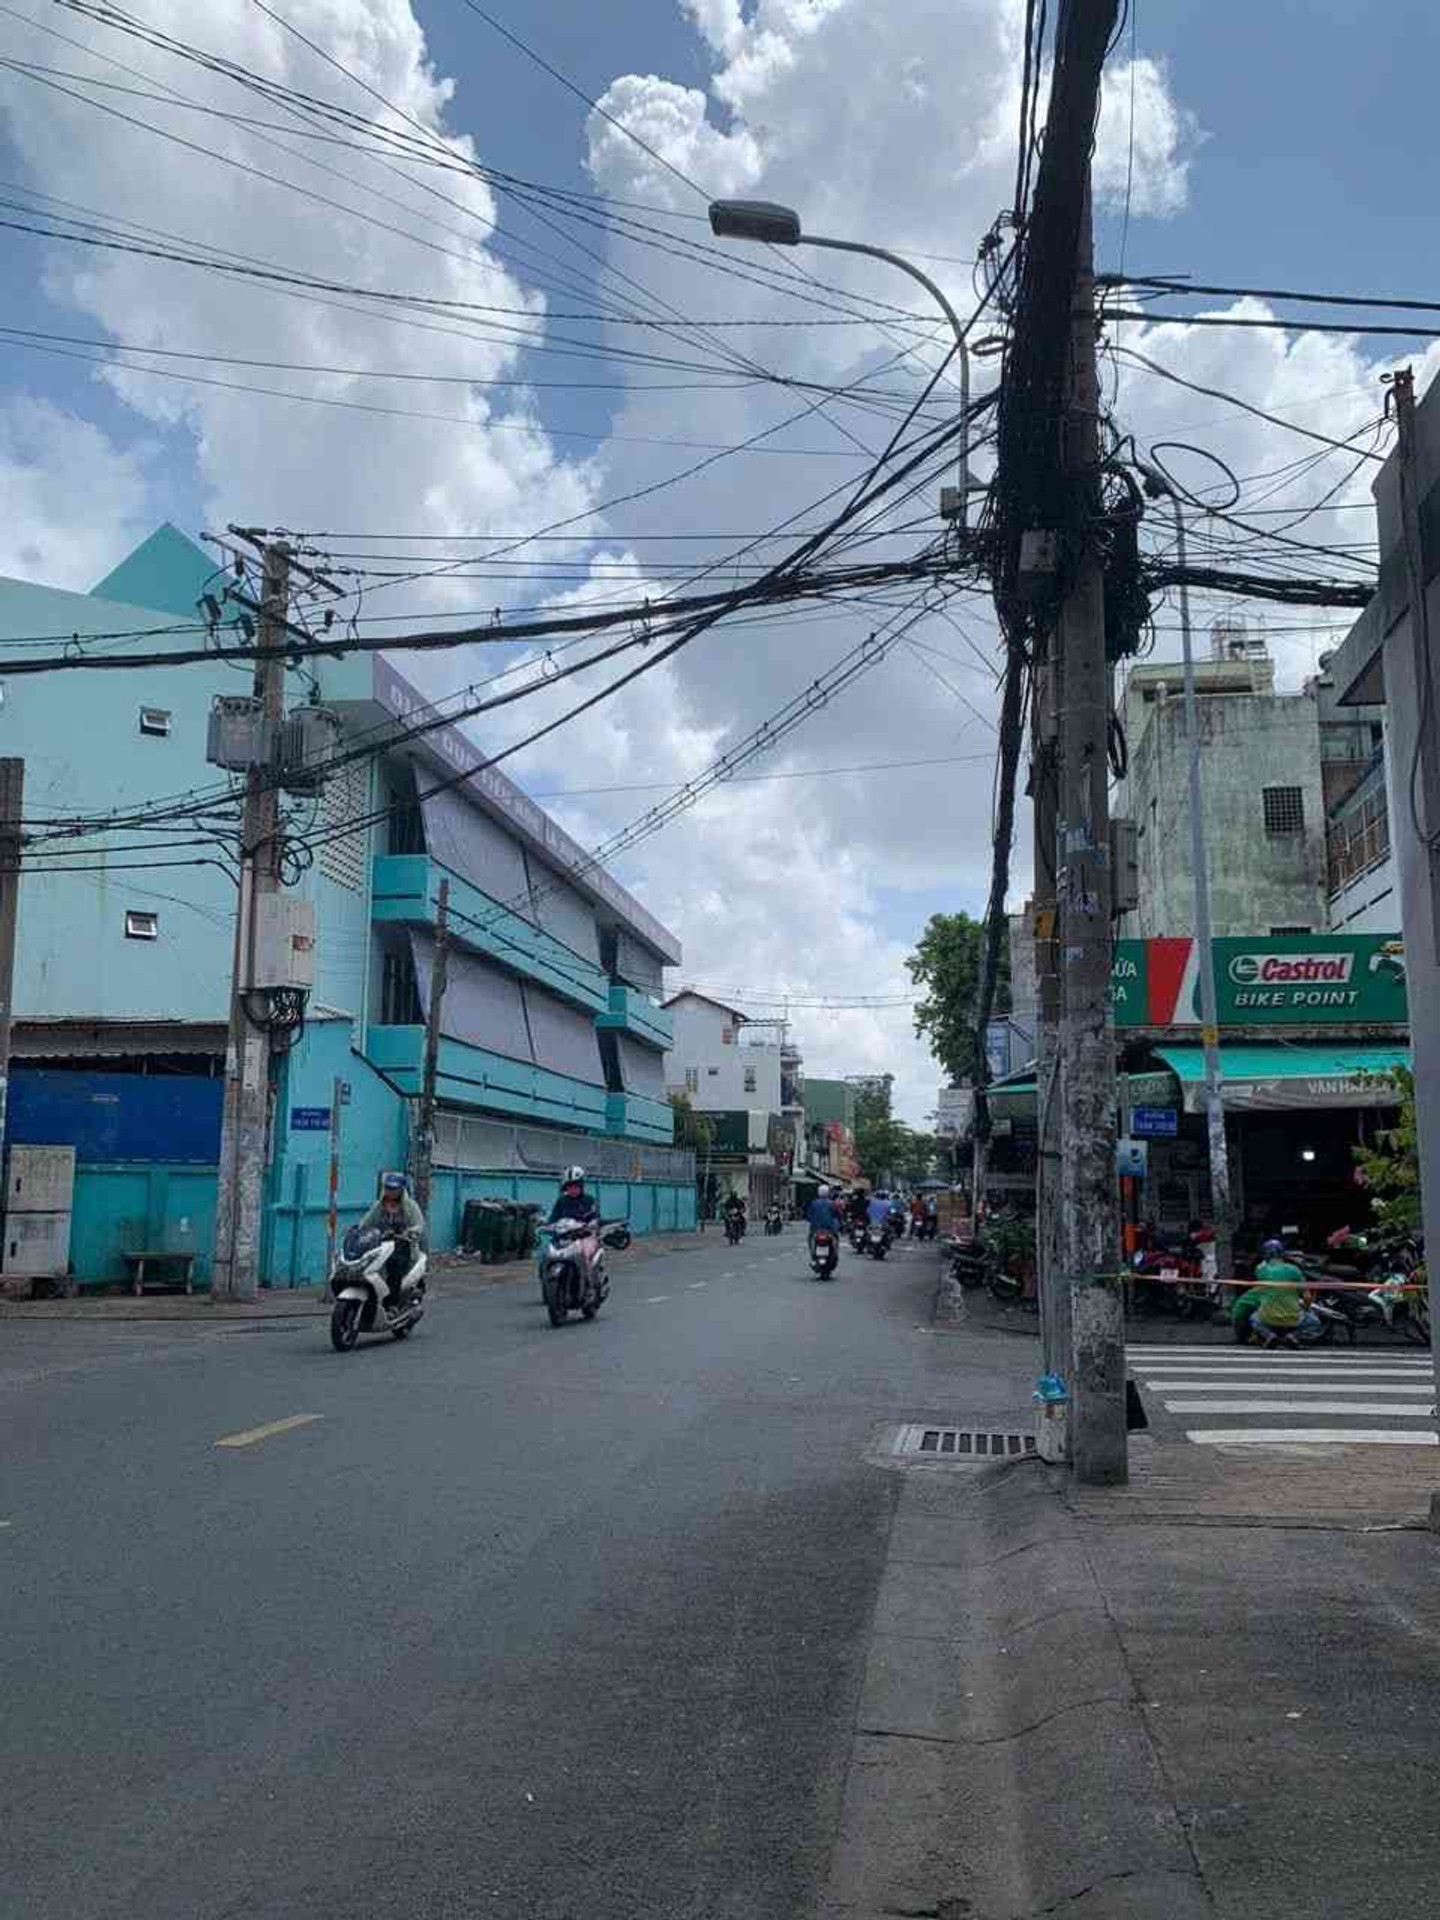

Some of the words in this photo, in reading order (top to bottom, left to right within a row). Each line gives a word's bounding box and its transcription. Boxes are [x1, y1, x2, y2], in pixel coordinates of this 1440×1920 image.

[1261, 957, 1347, 981] Castrol
[1235, 992, 1285, 1006] BIKE
[1291, 991, 1358, 1005] POINT
